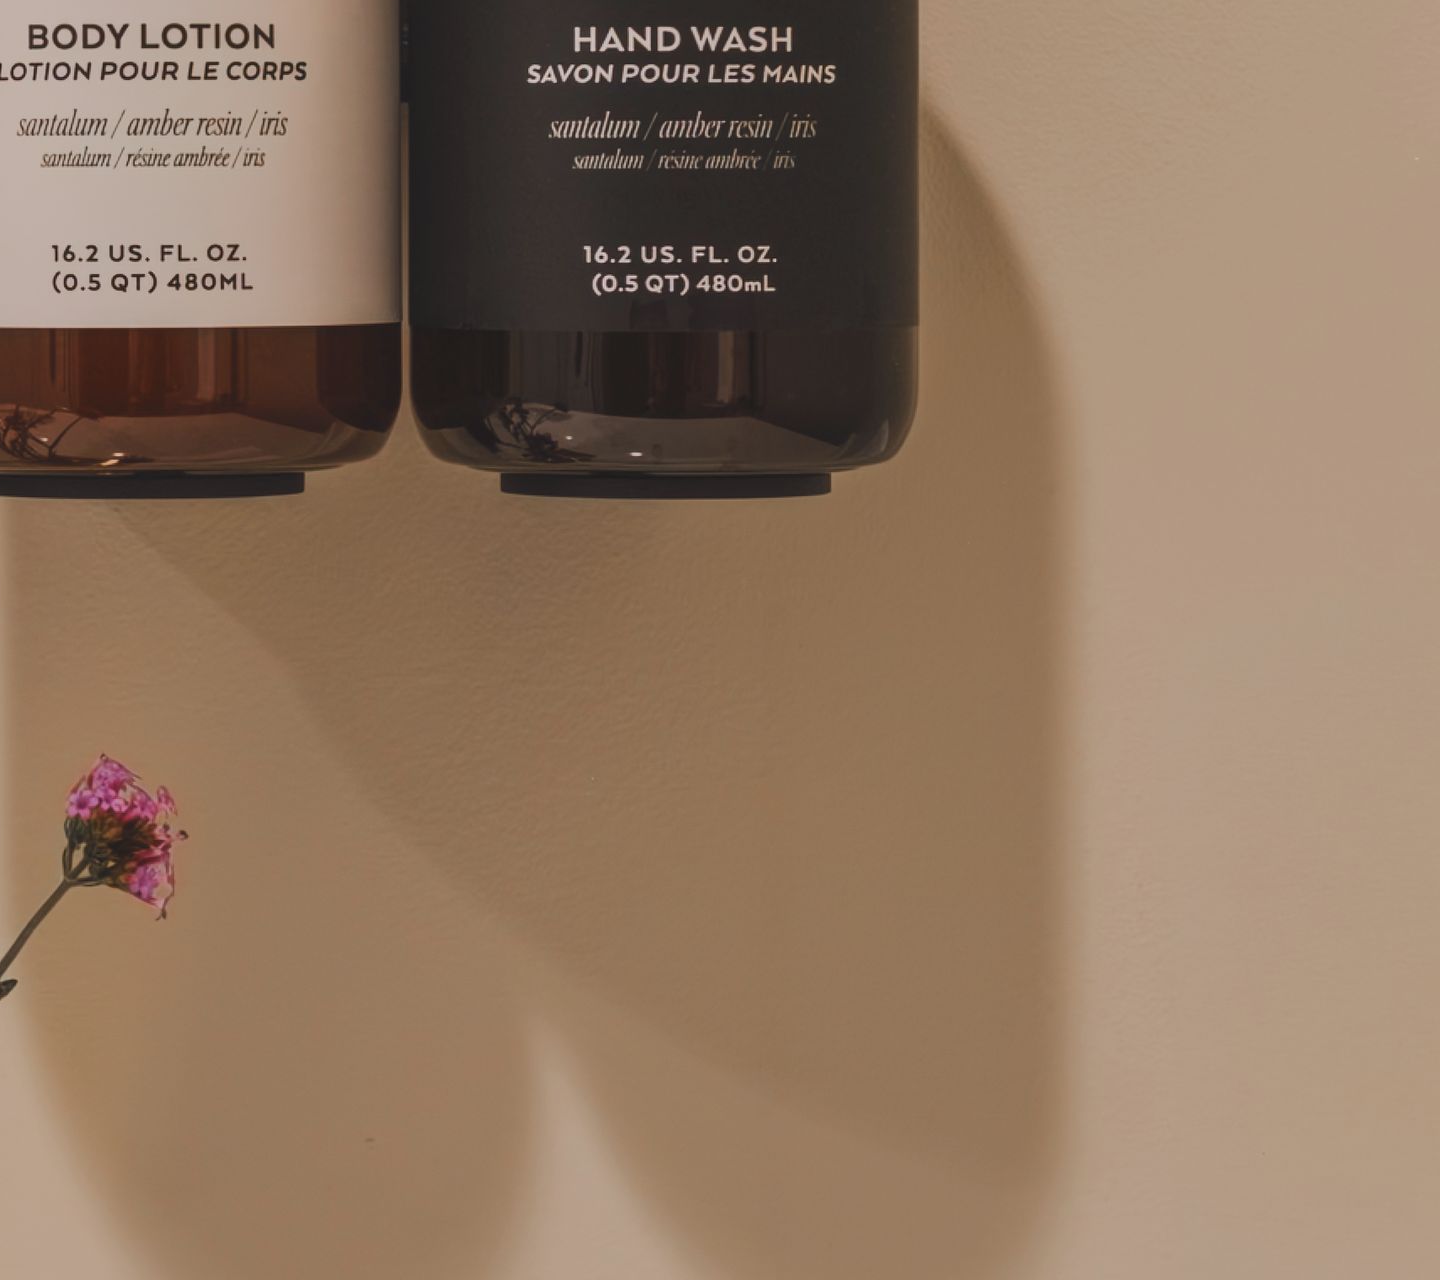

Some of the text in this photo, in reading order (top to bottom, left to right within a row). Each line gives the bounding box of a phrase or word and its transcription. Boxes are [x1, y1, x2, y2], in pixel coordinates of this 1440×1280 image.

[28, 24, 276, 50] BODY LOTION
[573, 26, 793, 53] HAND WASH
[100, 62, 179, 81] POUR
[187, 62, 219, 81] LE
[226, 61, 308, 81] CORPS
[527, 63, 836, 84] SAVON POUR LES MAINS
[16, 108, 108, 137] santalum
[126, 108, 194, 137] amber
[195, 111, 242, 137] resin
[259, 111, 288, 137] iris
[548, 110, 640, 139] santalum
[659, 110, 726, 139] amber
[727, 113, 773, 139] resin
[789, 113, 817, 139] iris
[40, 145, 111, 168] santalum
[125, 147, 171, 168] résine
[172, 145, 230, 168] ambrée
[242, 147, 266, 168] iris
[572, 148, 644, 169] santalum
[772, 150, 796, 169] iris
[51, 244, 248, 263] 16.2 US. FL. OZ.
[583, 245, 777, 264] 16.2 US. FL. OZ.
[52, 271, 253, 294] (0.5 QT) 480ML
[592, 273, 777, 296] (0.5 QT) 480mL
